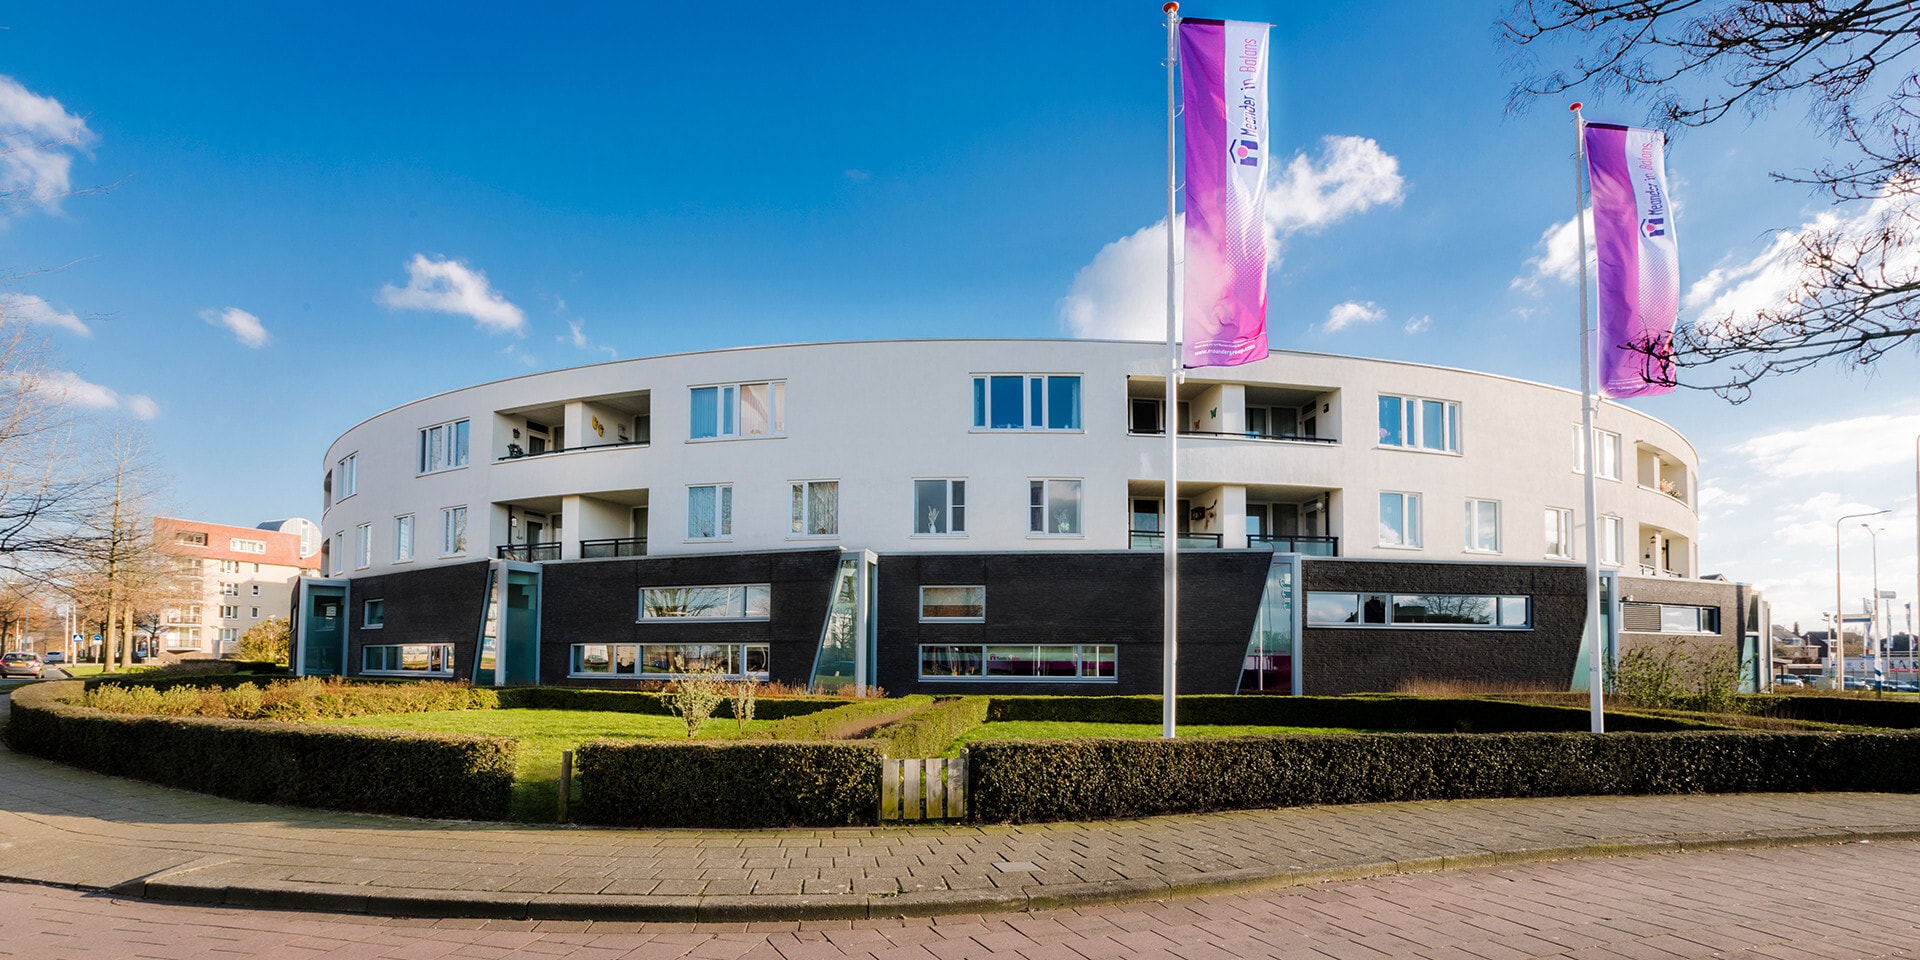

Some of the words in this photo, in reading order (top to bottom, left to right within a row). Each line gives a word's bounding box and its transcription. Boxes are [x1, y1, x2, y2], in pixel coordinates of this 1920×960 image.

[1239, 38, 1257, 72] Balans
[1240, 78, 1255, 90] in
[1239, 95, 1257, 137] Meander
[1639, 143, 1652, 170] Balans
[1644, 173, 1655, 181] in
[1645, 183, 1663, 215] Meander
